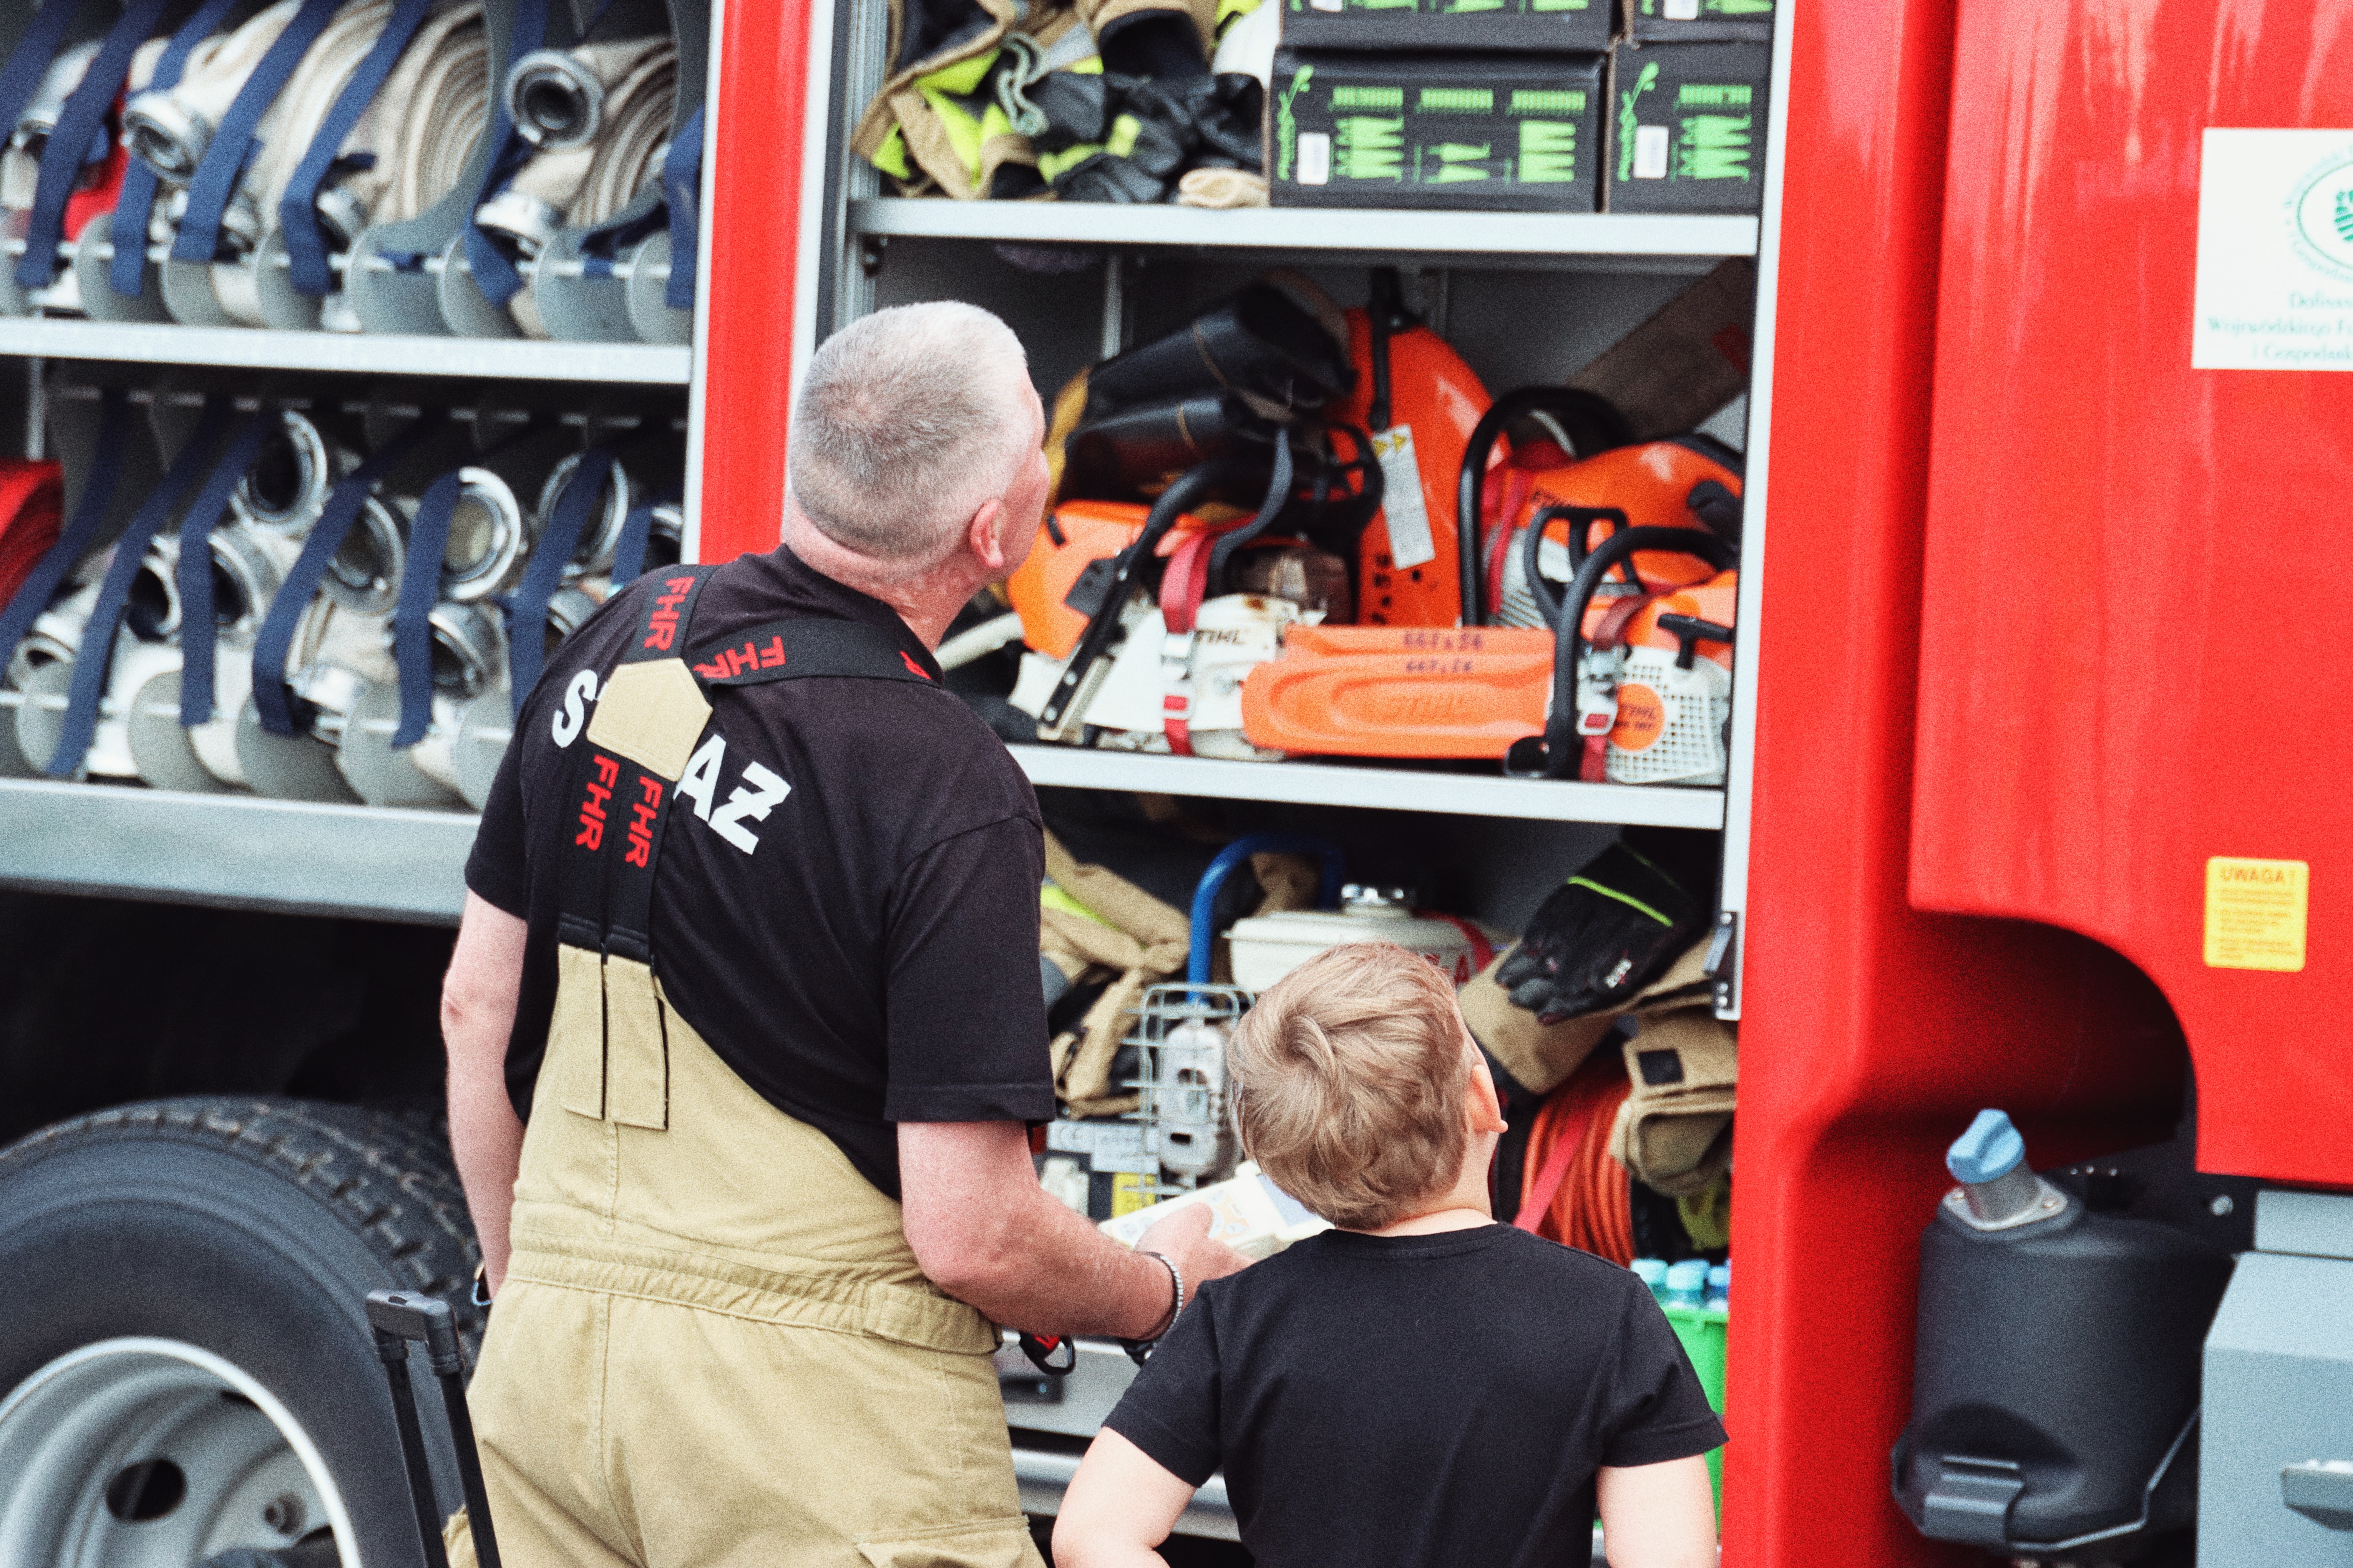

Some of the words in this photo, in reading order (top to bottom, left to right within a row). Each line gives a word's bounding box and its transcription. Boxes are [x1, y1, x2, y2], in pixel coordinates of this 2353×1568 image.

[643, 576, 695, 651] FHR
[1193, 628, 1246, 645] TIHL
[693, 635, 786, 678] FHR
[576, 755, 619, 850] FHR
[626, 776, 663, 867] FHR
